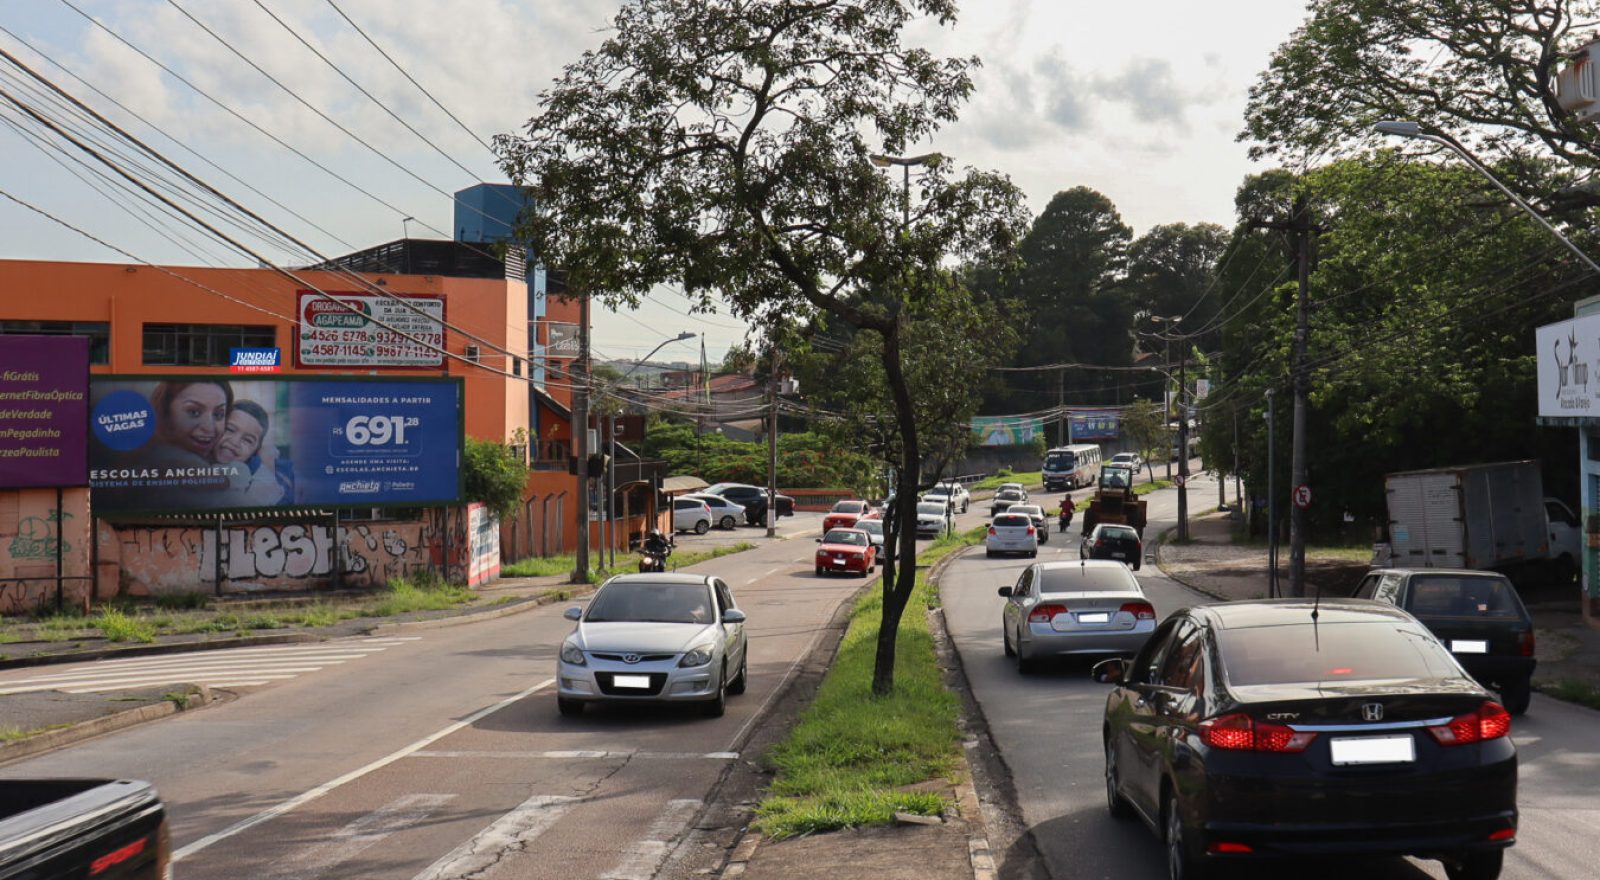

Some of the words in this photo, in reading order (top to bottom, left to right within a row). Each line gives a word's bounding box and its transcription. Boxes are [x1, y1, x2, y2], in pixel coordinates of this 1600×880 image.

[98, 409, 148, 425] ÚLTIMAS
[105, 419, 145, 433] VAGAS
[90, 468, 159, 479] ESCOLAS
[165, 467, 239, 477] ANCHIETA
[1266, 712, 1300, 720] CITY
